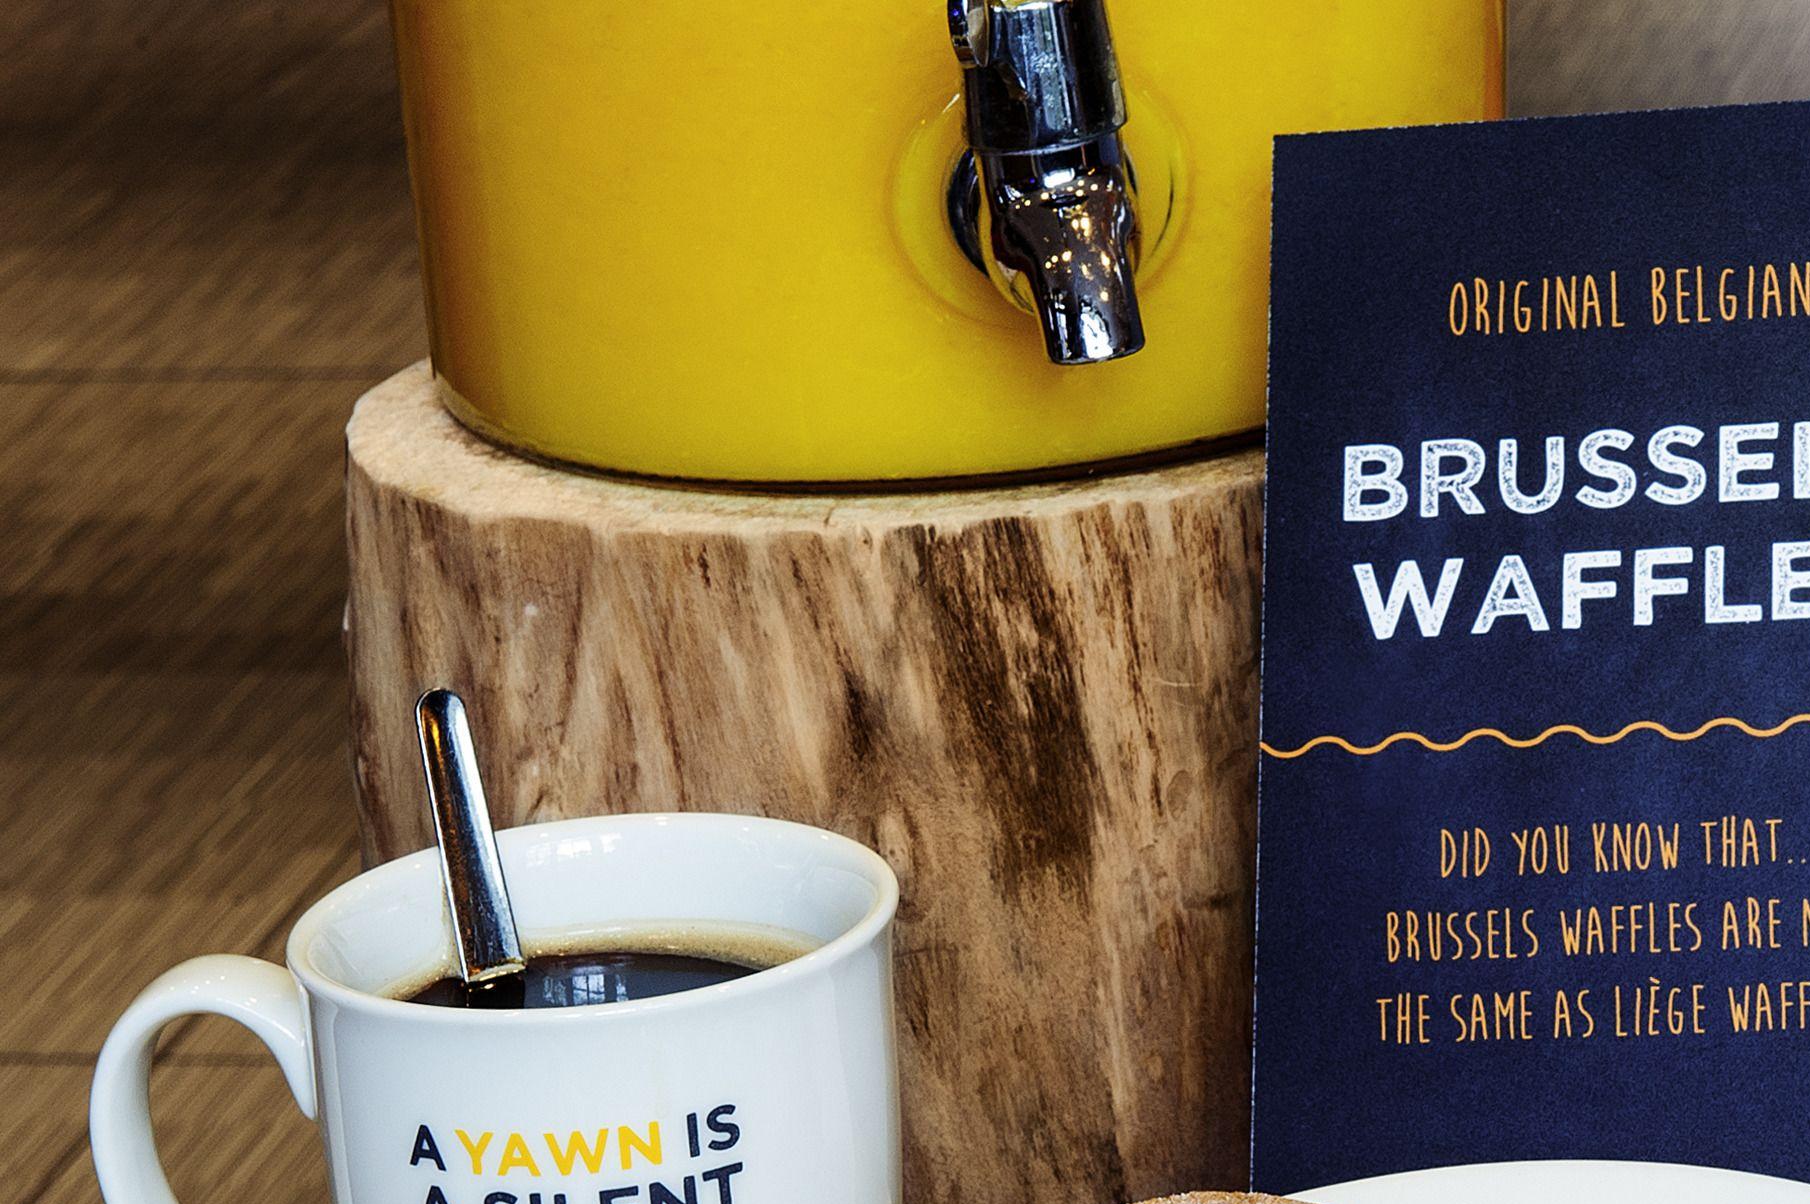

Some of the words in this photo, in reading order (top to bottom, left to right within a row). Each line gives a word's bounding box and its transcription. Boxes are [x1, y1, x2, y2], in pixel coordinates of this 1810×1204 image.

[1448, 271, 1626, 336] ORIGINAL
[1440, 827, 1491, 878] DID
[1511, 824, 1570, 875] YOU
[1592, 822, 1680, 872] KNOW
[1386, 908, 1540, 963] BRUSSELS
[1560, 902, 1702, 956] WAFFLES
[1722, 897, 1781, 949] ARE
[1376, 992, 1431, 1044] THE
[1450, 990, 1533, 1042] SAME
[1553, 989, 1595, 1038] AS
[1614, 976, 1705, 1037] LIÈGE
[409, 1123, 447, 1172] A
[455, 1120, 664, 1178] YAWN
[686, 1104, 742, 1159] IS
